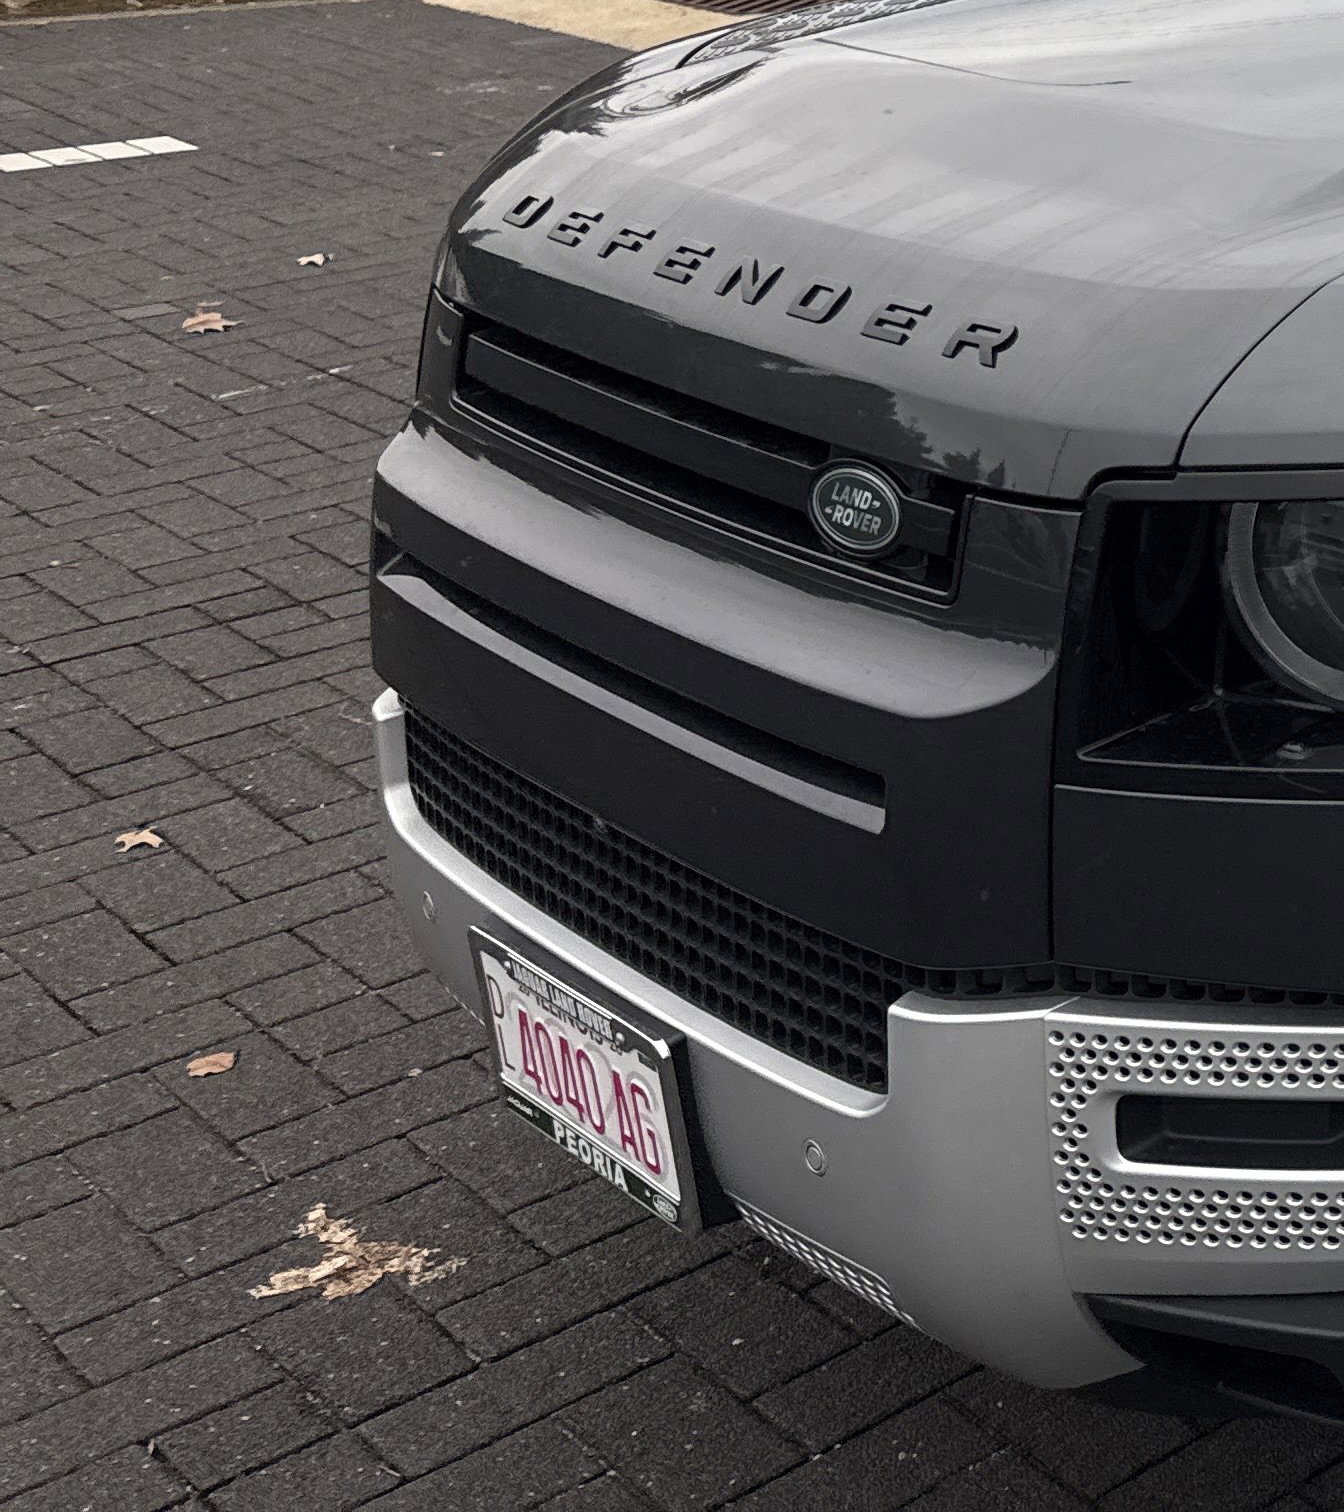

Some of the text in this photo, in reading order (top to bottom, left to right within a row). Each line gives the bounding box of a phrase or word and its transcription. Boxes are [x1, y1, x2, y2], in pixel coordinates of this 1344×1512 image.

[502, 193, 1019, 368] DEFENDER
[548, 983, 578, 1018] LAND
[575, 1000, 614, 1042] ROVER
[518, 1007, 662, 1176] 4040 AG
[552, 1119, 629, 1193] PEORIA
